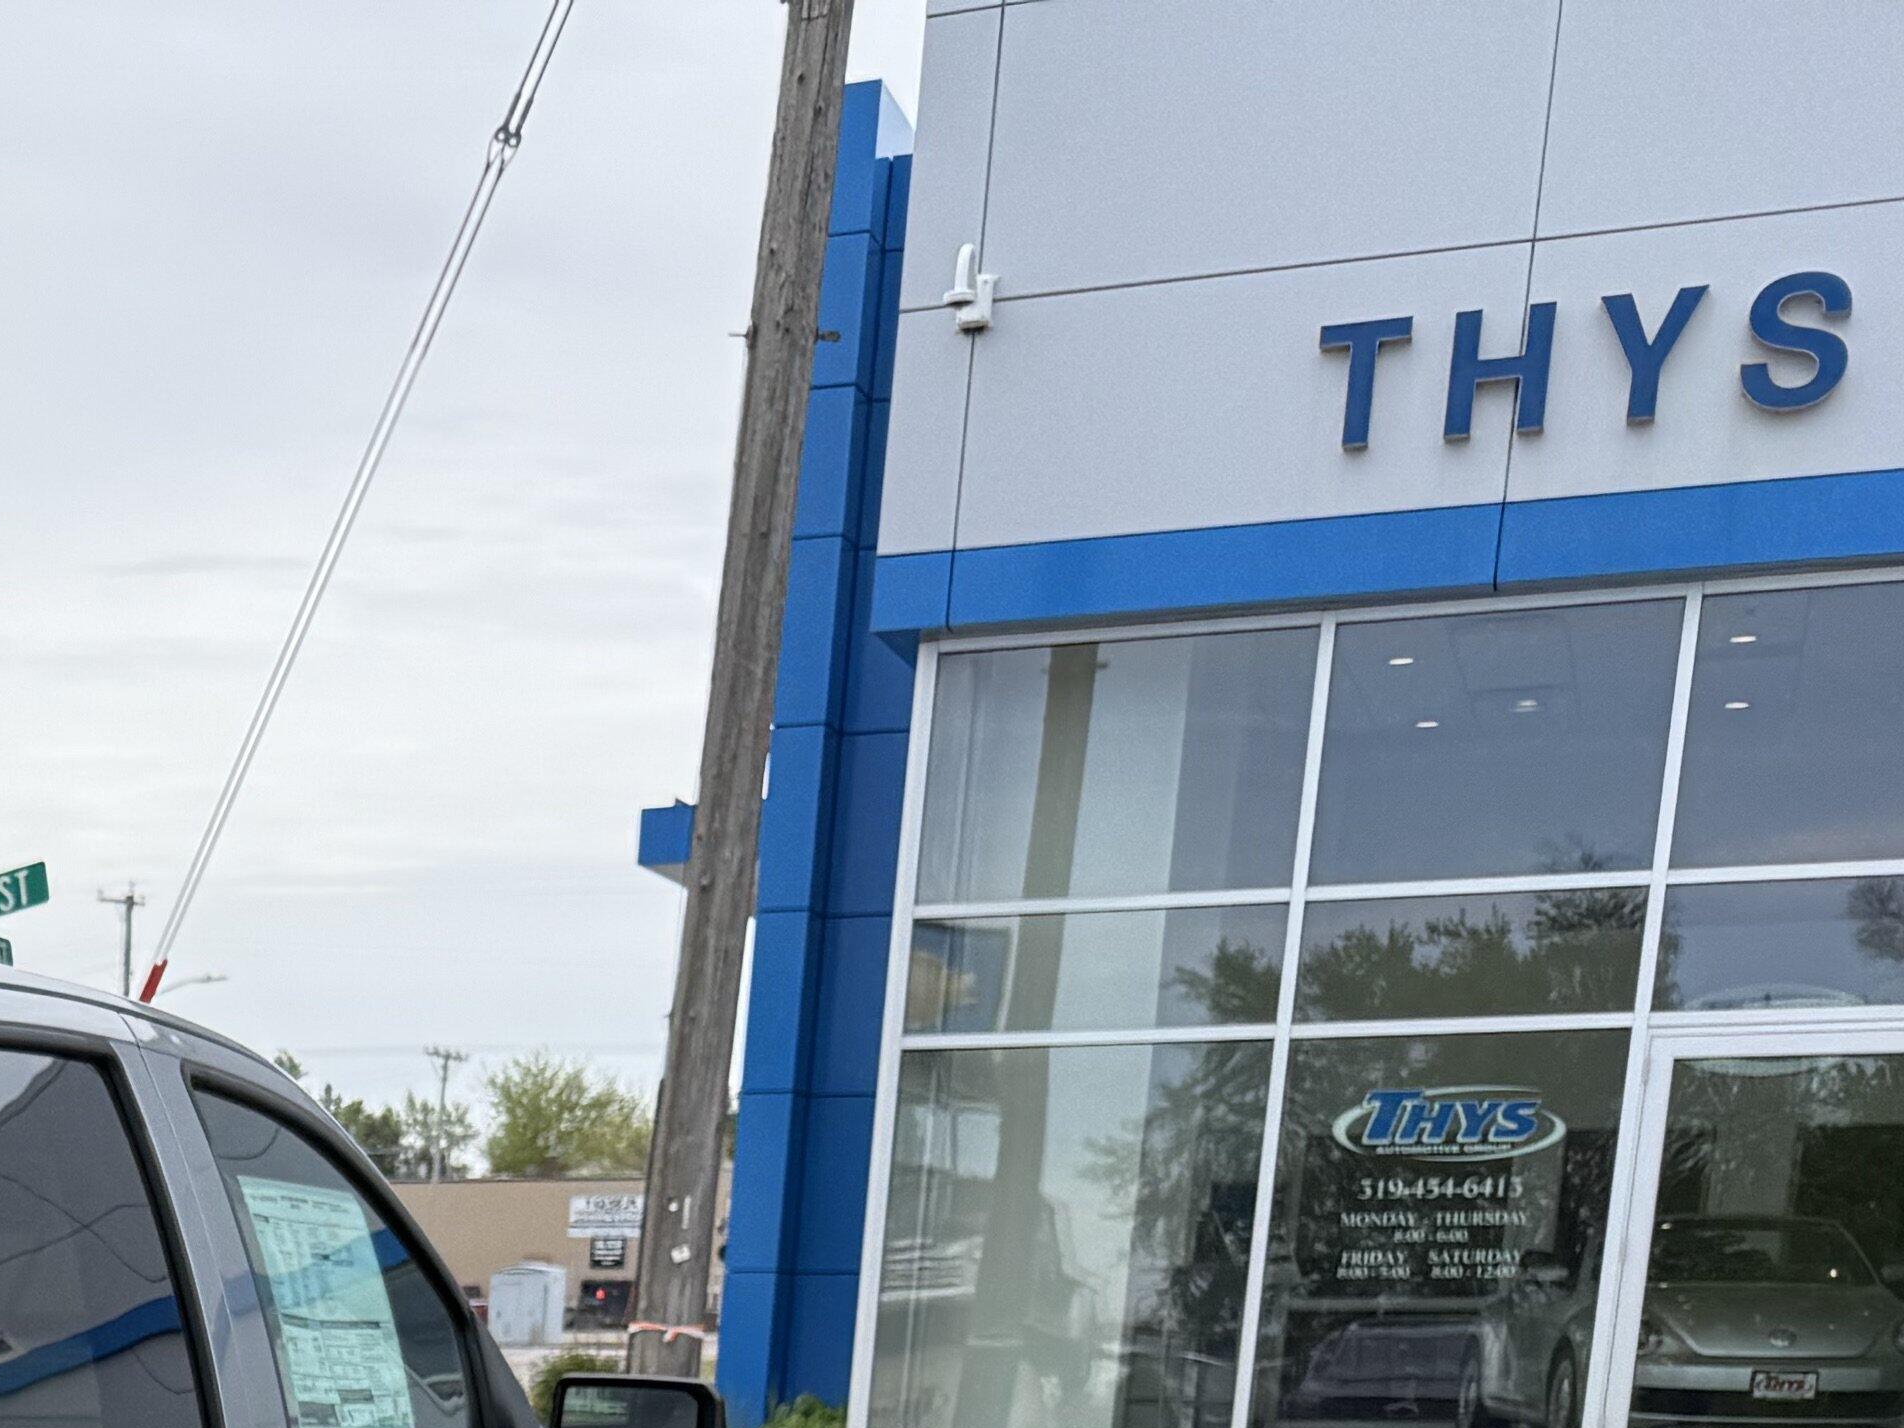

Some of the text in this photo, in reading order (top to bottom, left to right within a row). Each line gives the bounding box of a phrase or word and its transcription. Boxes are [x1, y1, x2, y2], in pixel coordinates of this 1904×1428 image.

[1320, 271, 1853, 450] THYS
[1361, 1087, 1542, 1145] THYS
[1340, 1211, 1416, 1228] MONDAY
[1435, 1210, 1527, 1227] THURSDAY
[1341, 1250, 1406, 1266] FRIDAY
[1427, 1248, 1521, 1265] SATURDAY
